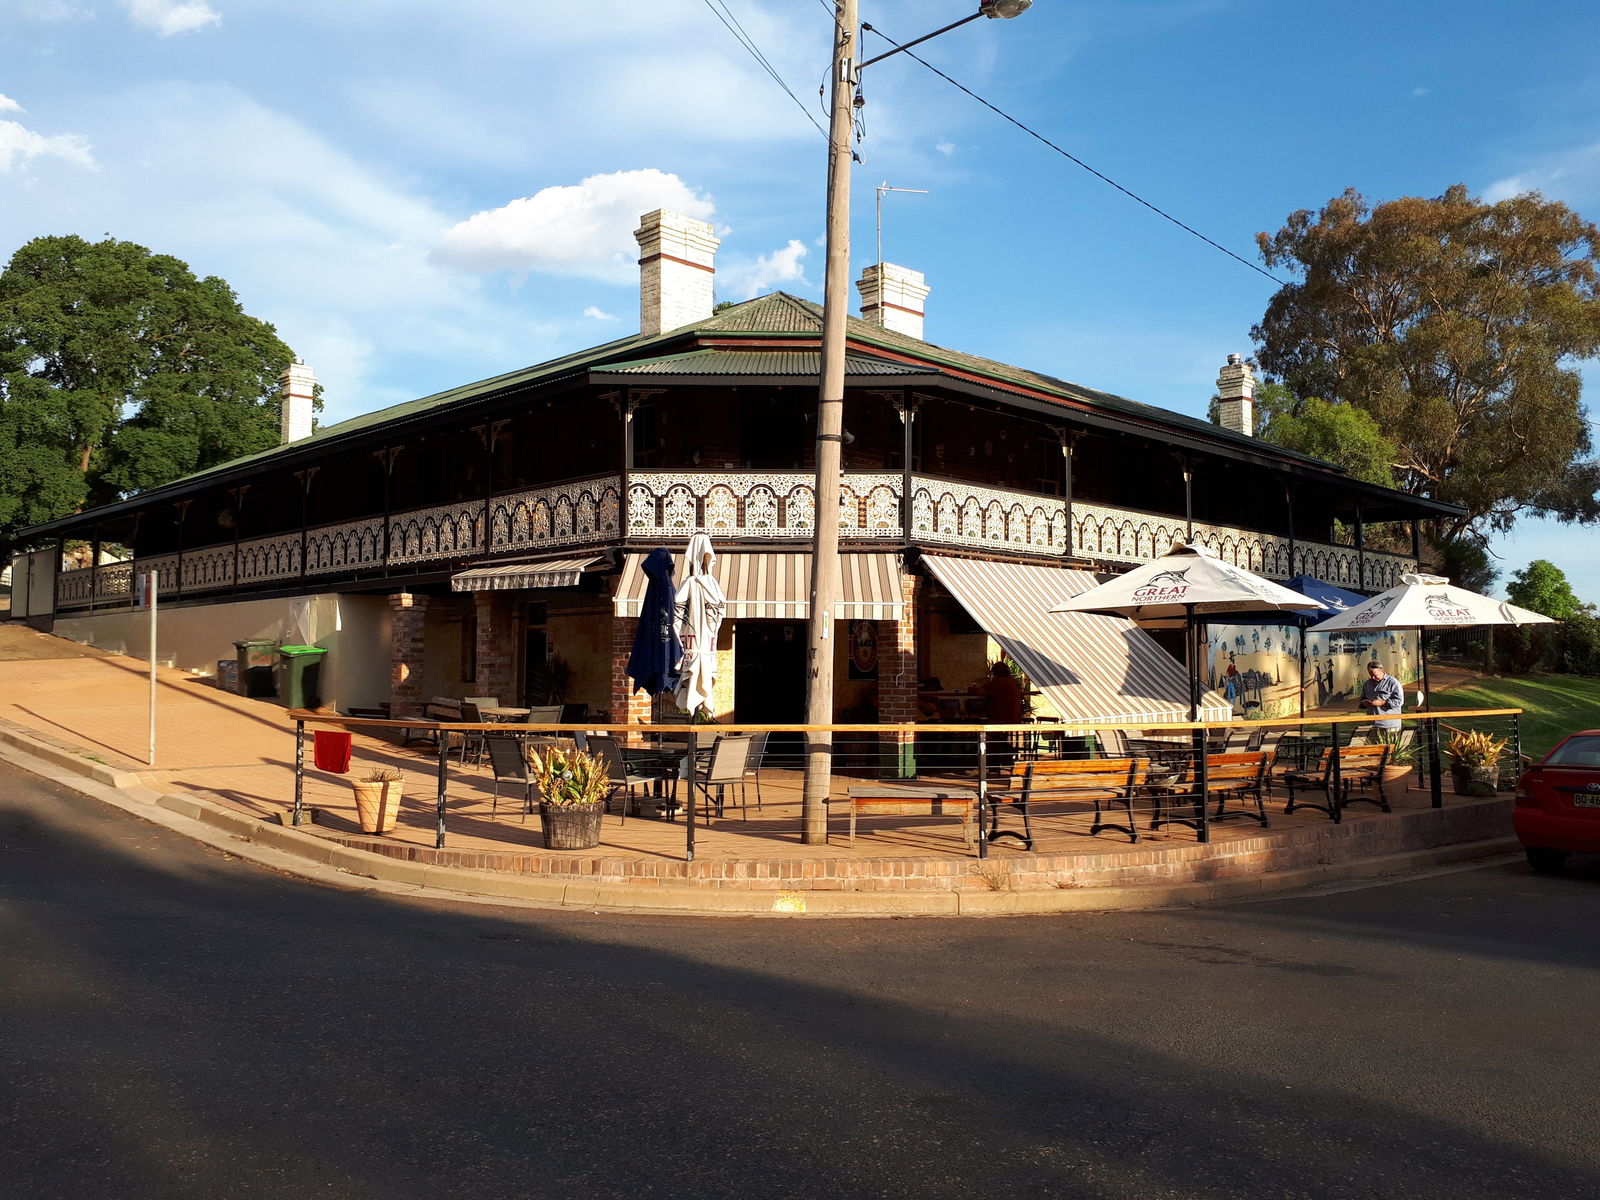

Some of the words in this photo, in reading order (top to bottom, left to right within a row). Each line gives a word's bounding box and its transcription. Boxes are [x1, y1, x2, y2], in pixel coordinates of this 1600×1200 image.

[1133, 586, 1189, 597] GREAT
[1131, 593, 1186, 602] NORTHERN
[1428, 608, 1471, 617] GREAT
